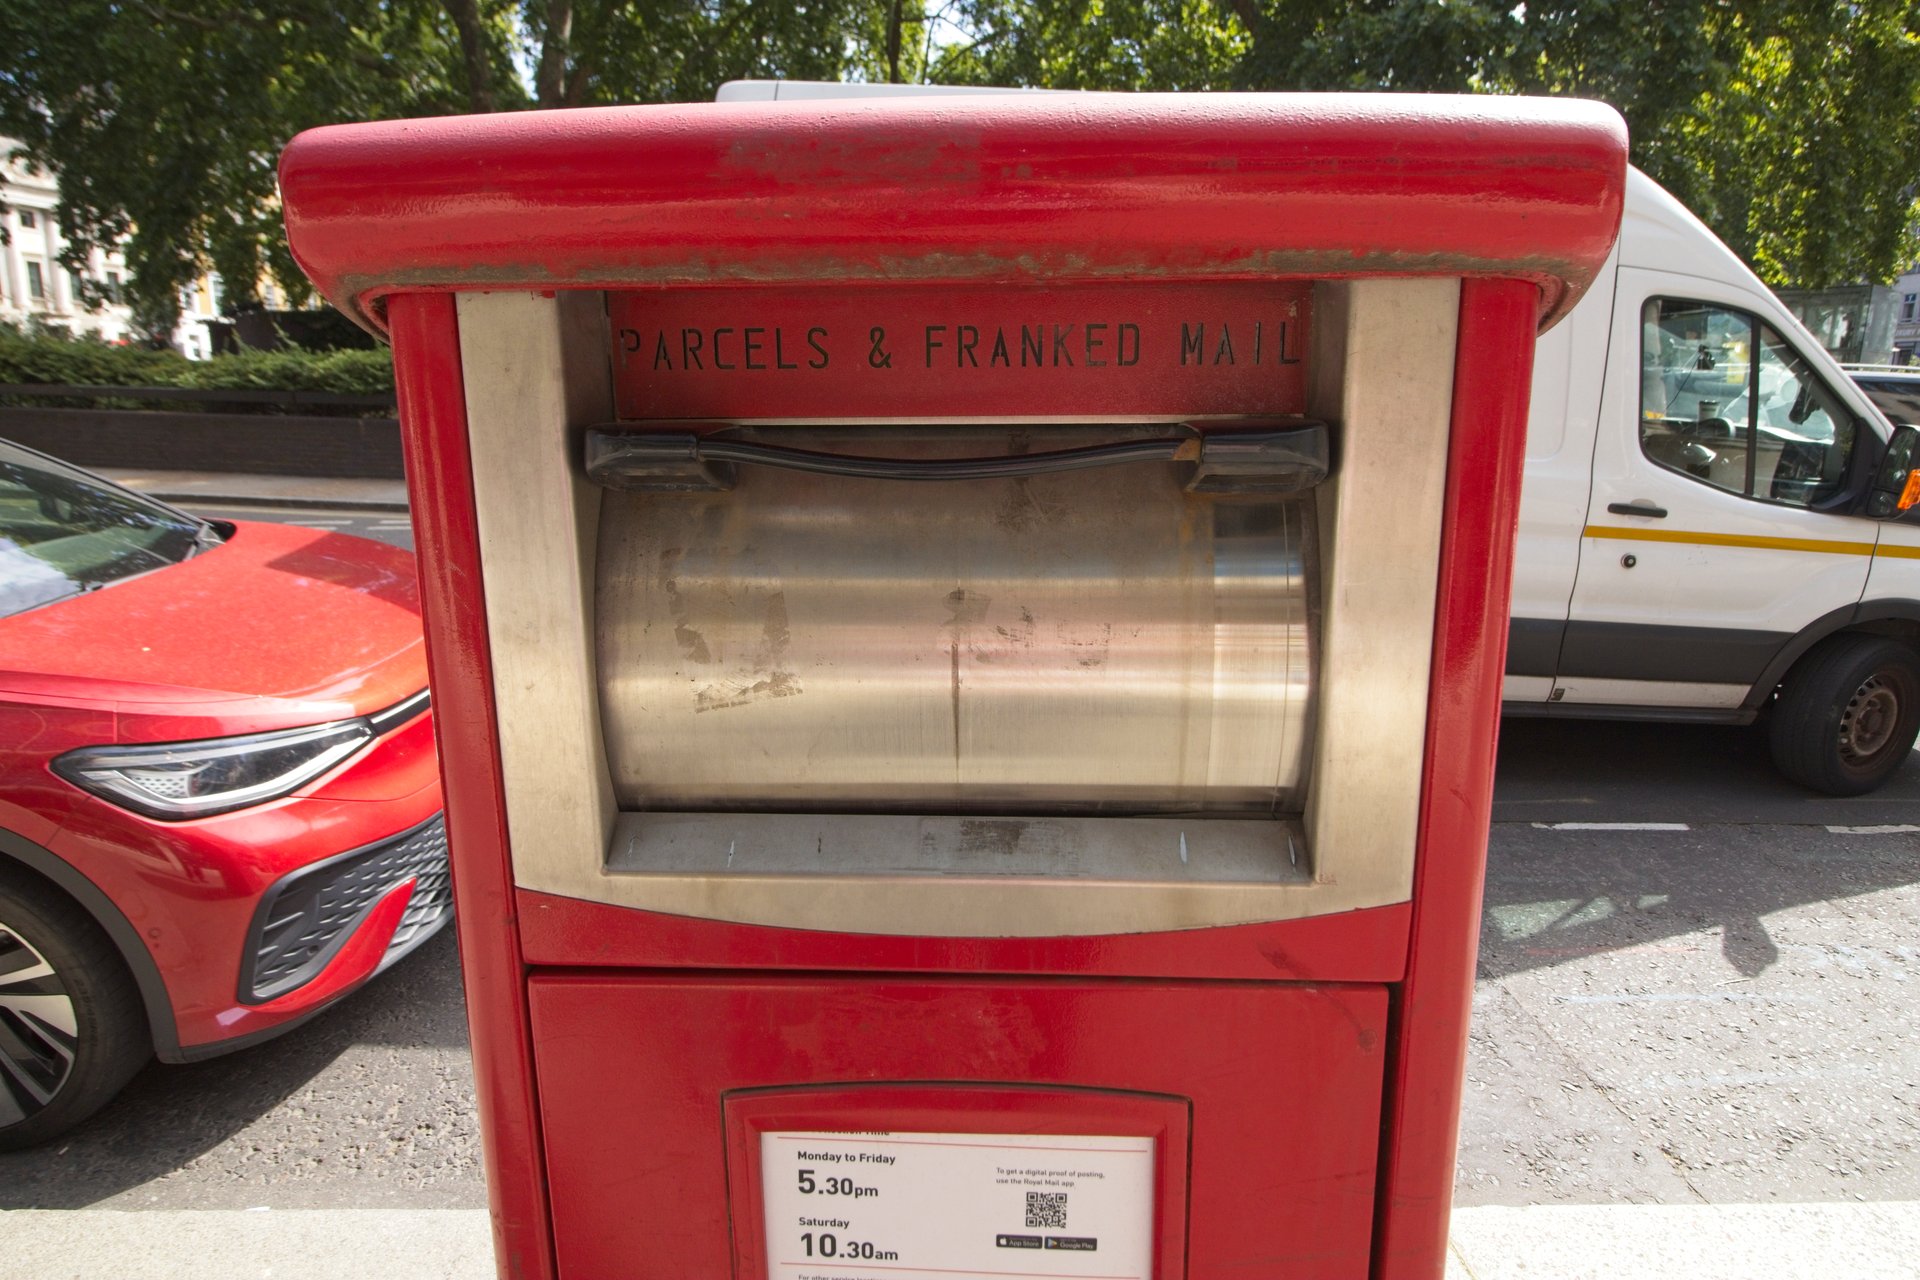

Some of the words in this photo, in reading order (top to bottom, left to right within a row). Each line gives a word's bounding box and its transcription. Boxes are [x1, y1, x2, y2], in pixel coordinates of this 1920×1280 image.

[620, 326, 829, 370] PARCELS
[868, 326, 892, 369] &
[925, 323, 1140, 368] FRANKED
[1180, 321, 1300, 366] MAIL
[797, 1151, 842, 1163] Monday
[845, 1153, 856, 1162] to
[860, 1153, 896, 1166] Friday
[798, 1169, 879, 1199] 5.30pm
[1023, 1178, 1043, 1186] Royal
[798, 1217, 850, 1230] Saturday
[800, 1232, 899, 1261] 10.30am
